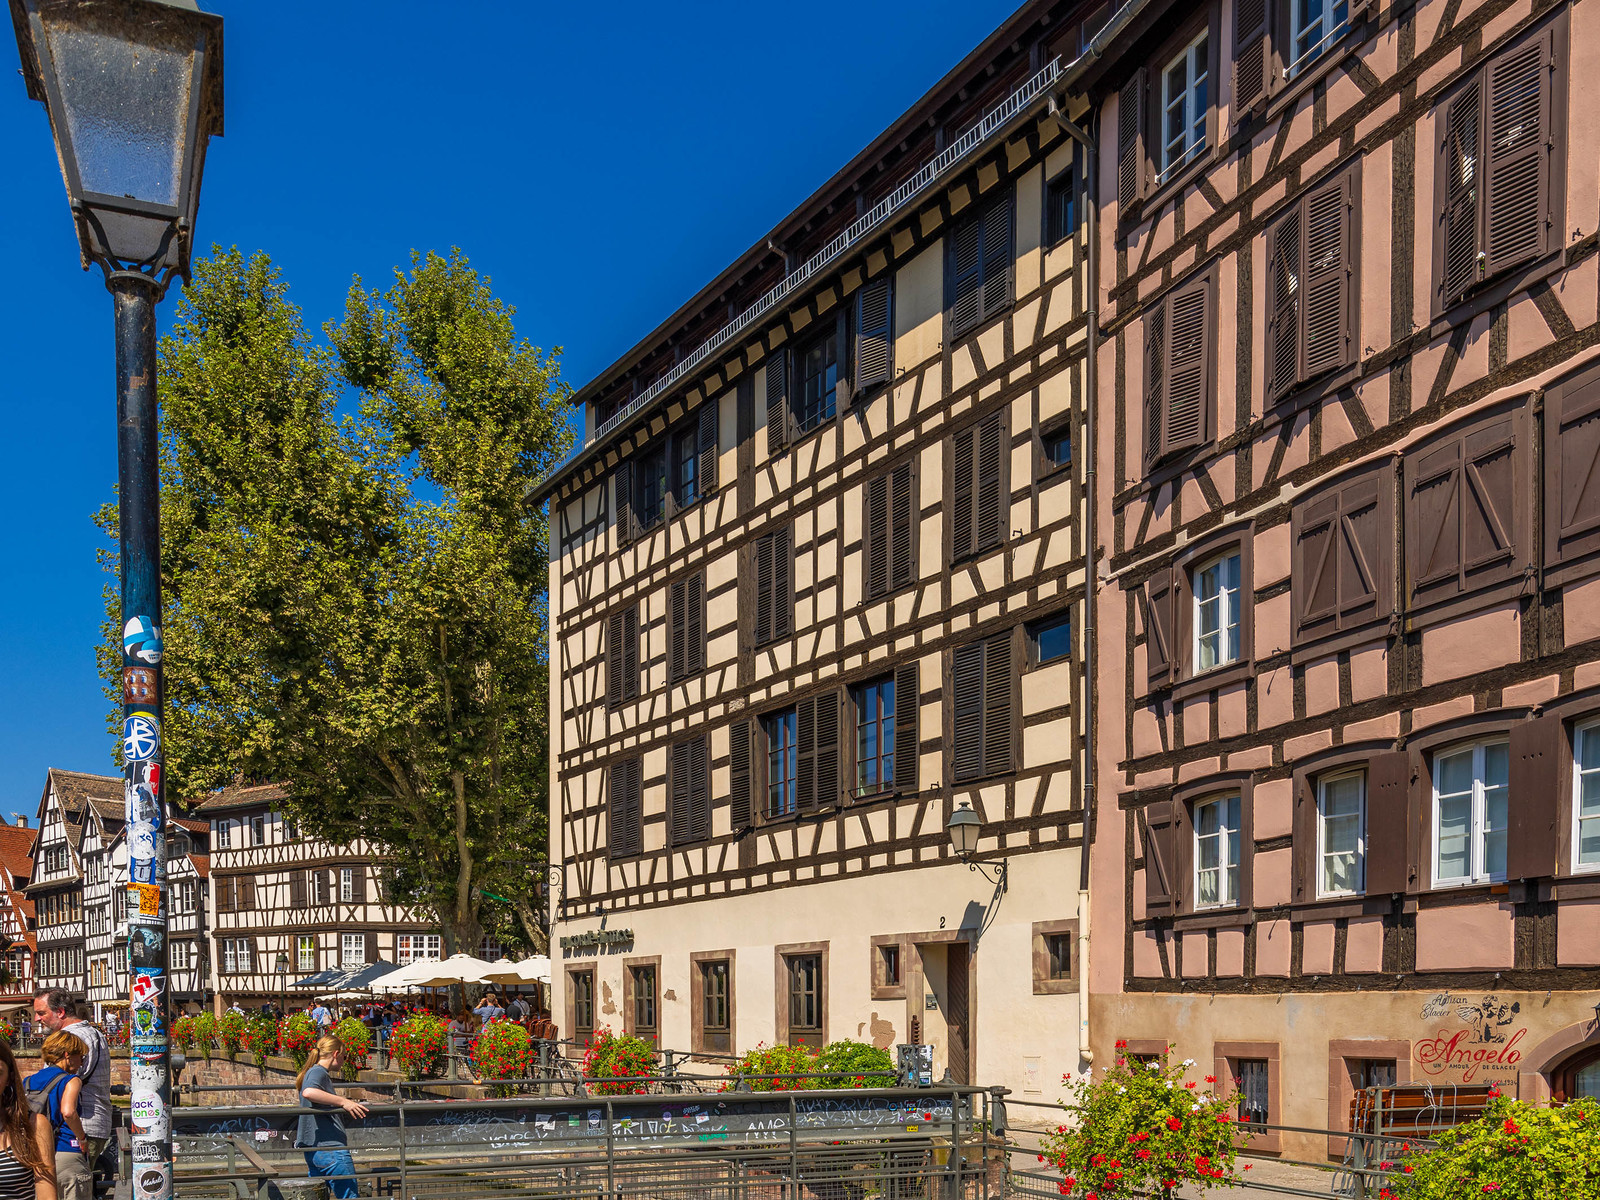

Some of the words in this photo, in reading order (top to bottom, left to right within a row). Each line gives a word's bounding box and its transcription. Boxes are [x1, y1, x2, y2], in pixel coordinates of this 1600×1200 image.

[940, 916, 946, 929] 2
[1420, 1003, 1451, 1020] Glacier
[1413, 1027, 1527, 1083] Angelo
